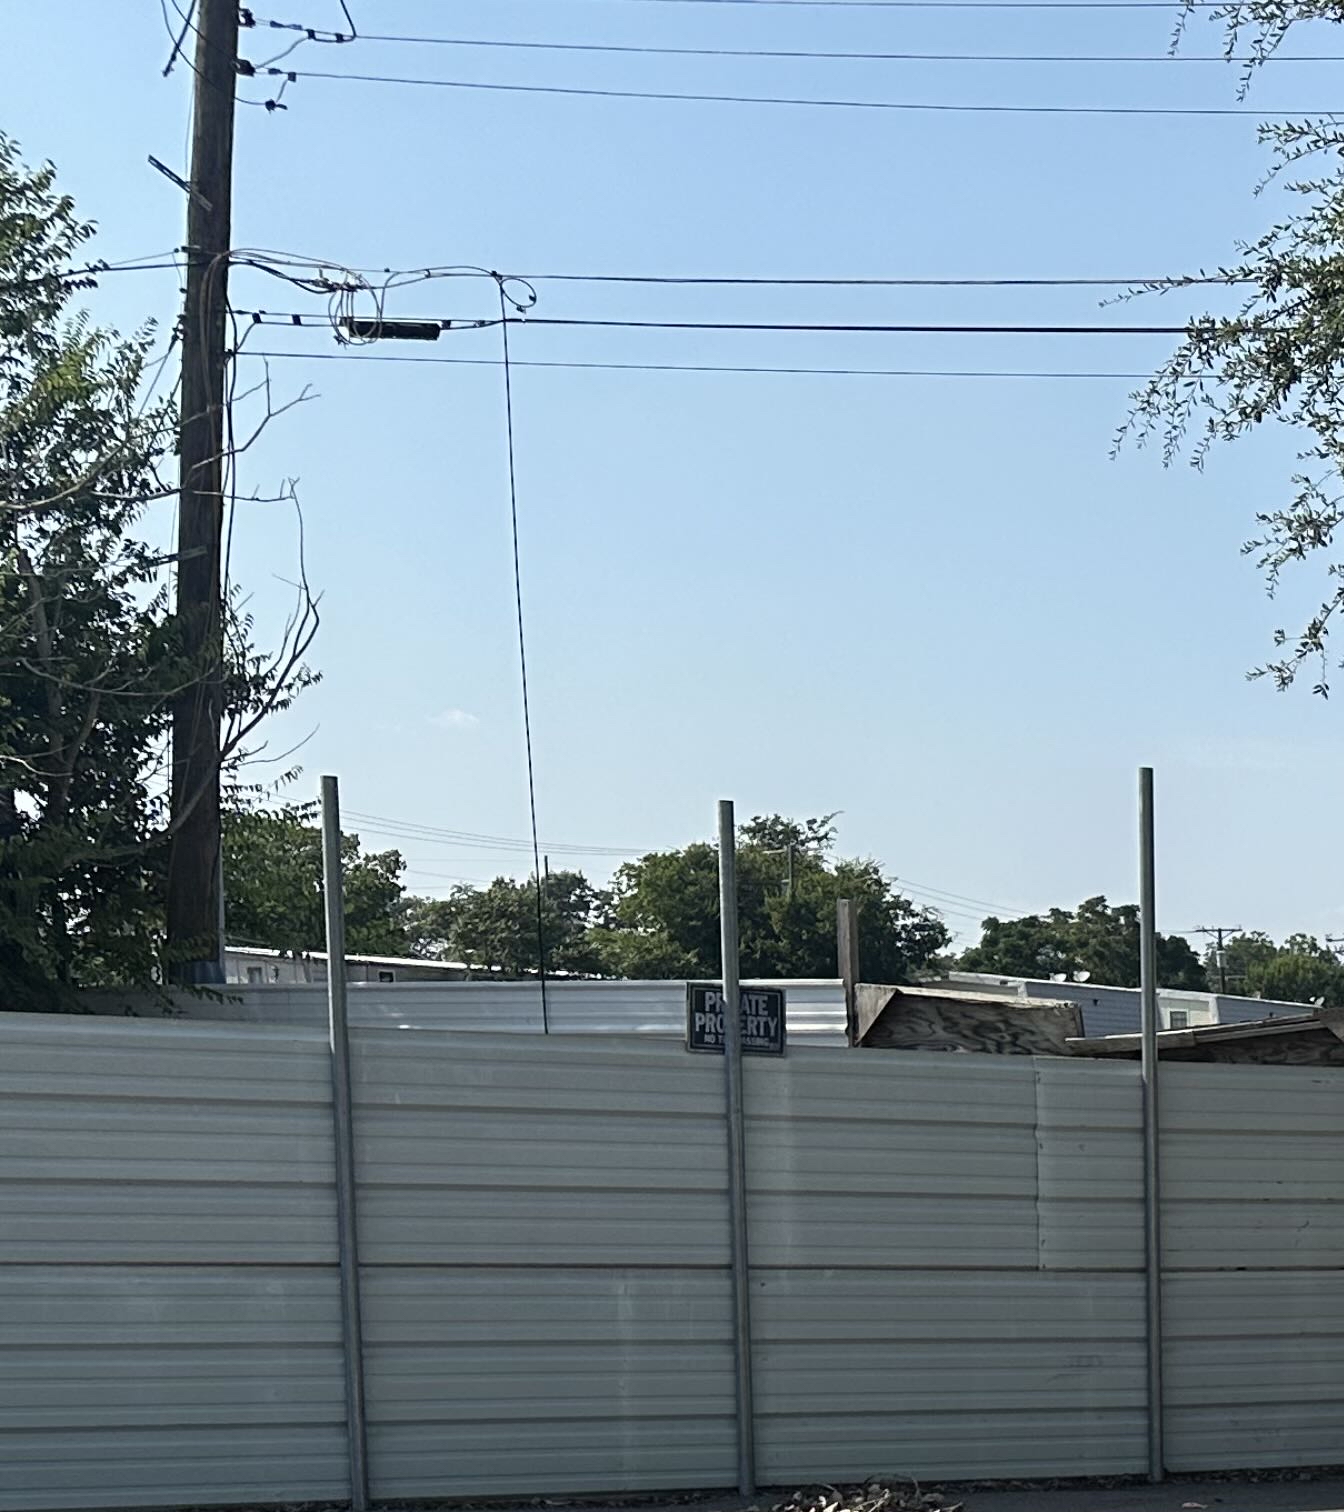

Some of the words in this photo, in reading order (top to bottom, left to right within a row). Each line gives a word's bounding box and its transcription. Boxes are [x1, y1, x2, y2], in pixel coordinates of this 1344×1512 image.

[705, 991, 768, 1016] PRATE
[695, 1012, 777, 1037] PROERTY
[704, 1033, 716, 1044] NO
